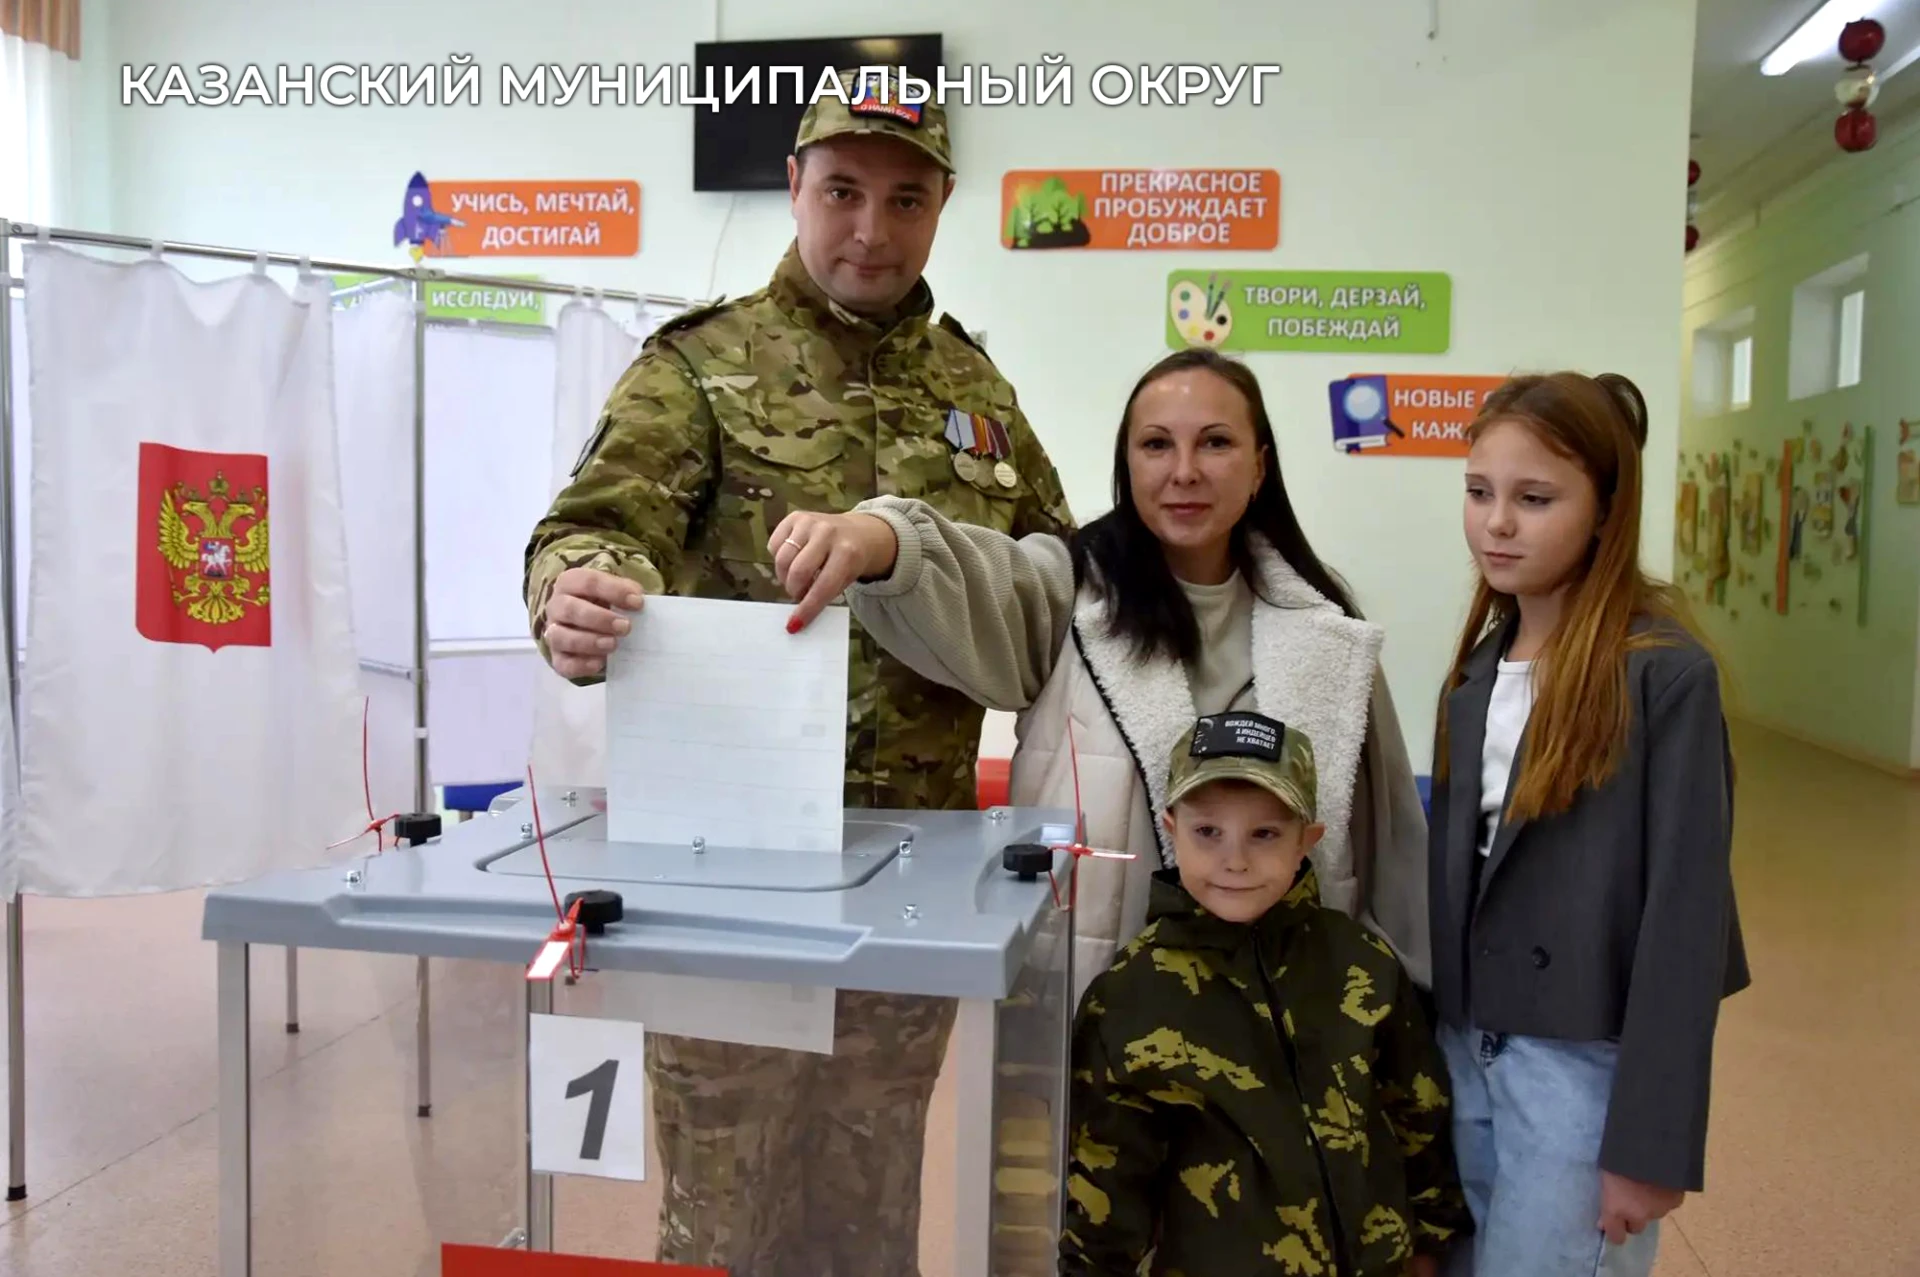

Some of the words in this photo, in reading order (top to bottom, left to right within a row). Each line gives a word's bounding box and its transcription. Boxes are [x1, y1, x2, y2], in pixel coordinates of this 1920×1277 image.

[1101, 172, 1262, 194] ПРЕКРАСНОЕ
[451, 193, 530, 215] УЧИСЬ,
[535, 188, 635, 215] МЕЧТАЙ,
[1094, 198, 1268, 222] ПРОБУЖДАЕТ
[481, 221, 601, 249] ДОСТИГАЙ
[1127, 223, 1230, 247] ДОБРОЕ
[1244, 286, 1324, 309] ТВОРИ,
[1330, 284, 1427, 310] ДЕРЗАЙ,
[1268, 316, 1400, 341] ПОБЕЖДАЙ
[1394, 388, 1476, 409] НОВЫЕ
[1236, 736, 1246, 744] НЕ
[1246, 736, 1276, 750] ХВАТАЕТ
[564, 1058, 620, 1161] 1
